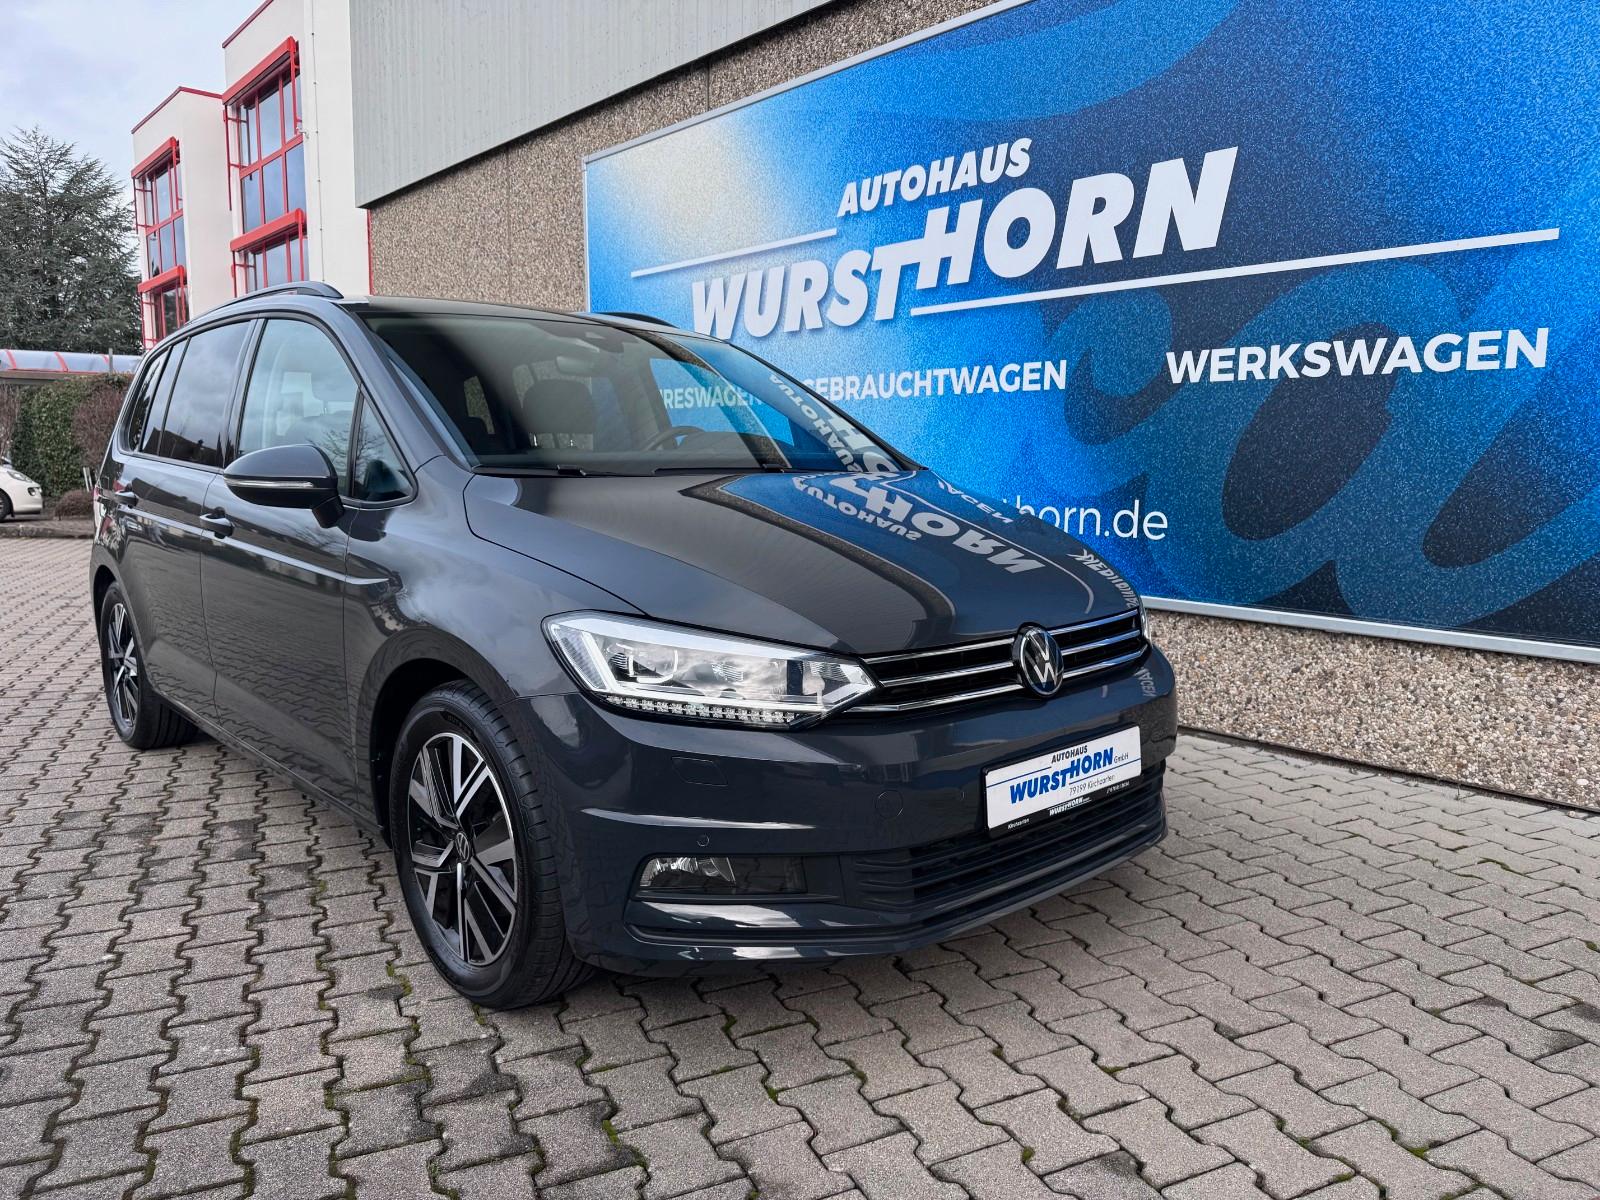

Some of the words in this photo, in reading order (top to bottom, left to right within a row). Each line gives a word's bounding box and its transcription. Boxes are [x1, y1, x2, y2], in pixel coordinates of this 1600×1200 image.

[838, 138, 1032, 218] AUTOHAUS
[692, 147, 1238, 340] WURSTHORN
[1166, 328, 1549, 384] WERKSWAGEN
[660, 384, 762, 408] RESWAGEN
[1009, 747, 1114, 804] WURSTHORN
[1113, 752, 1129, 764] GmbH
[1052, 745, 1088, 764] AUTOHAUS
